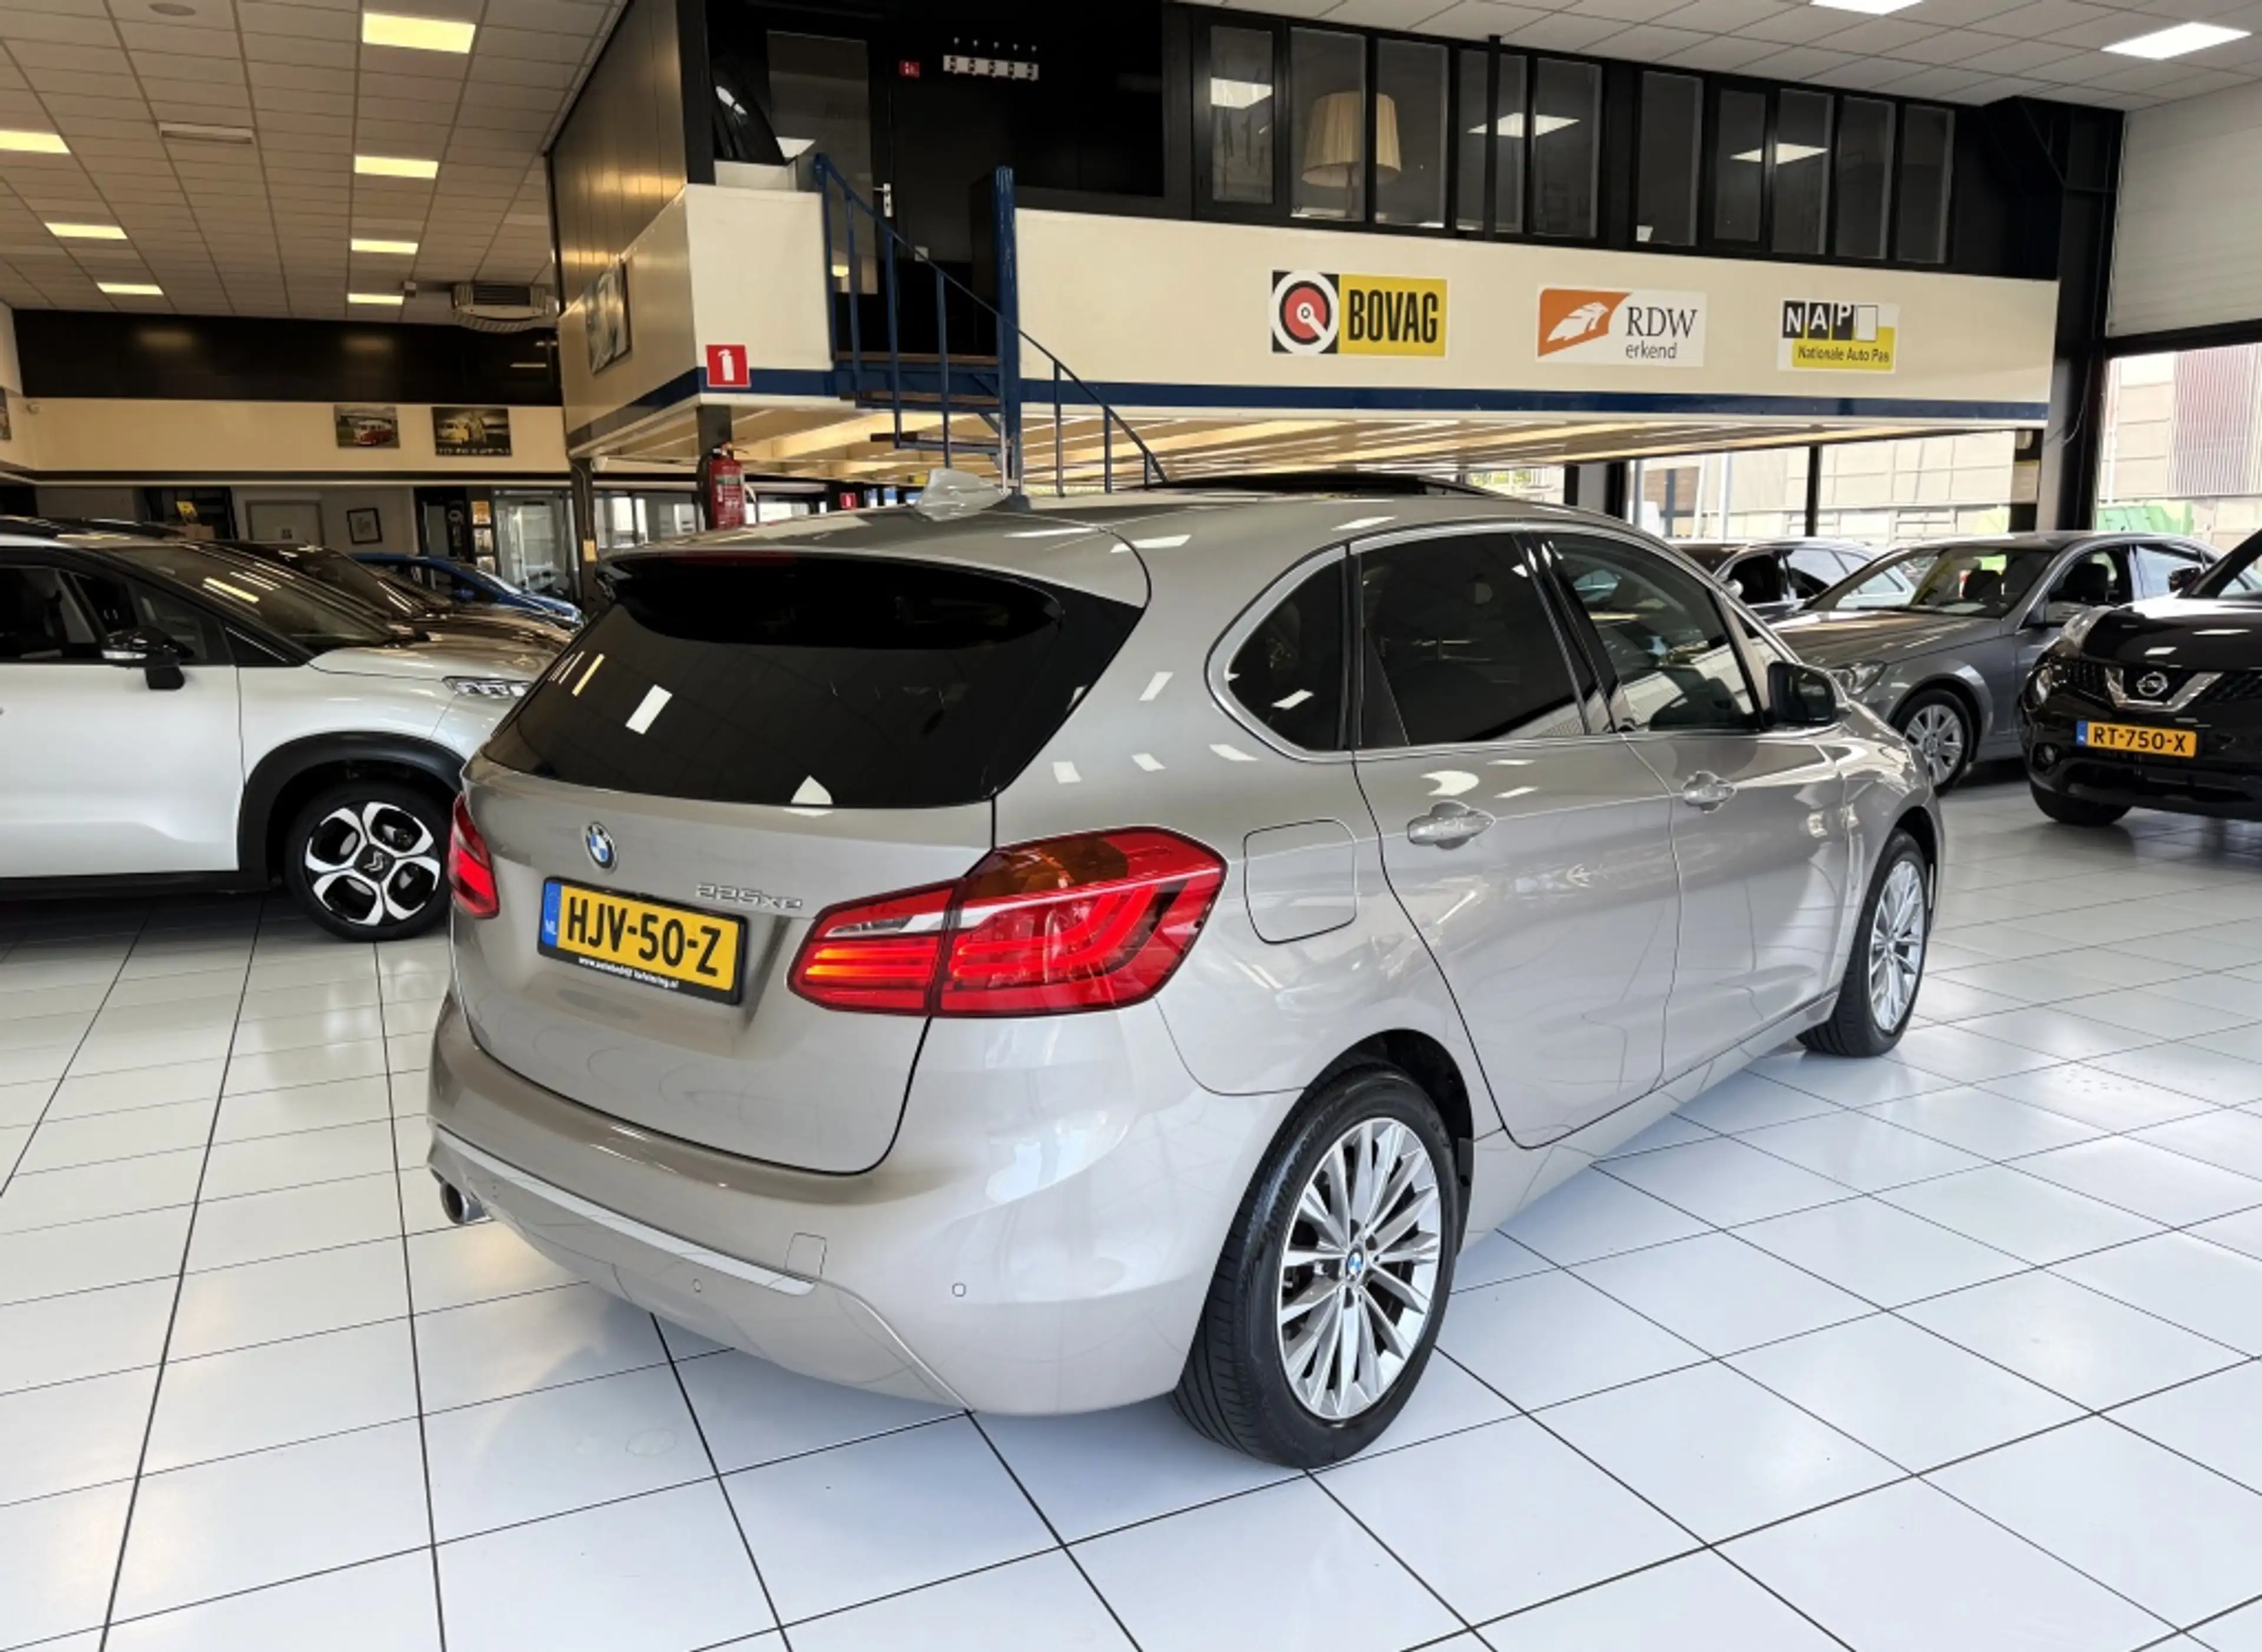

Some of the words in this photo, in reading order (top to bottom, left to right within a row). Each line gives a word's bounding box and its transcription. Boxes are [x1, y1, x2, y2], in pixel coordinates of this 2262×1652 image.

[1348, 289, 1438, 343] BOVAG
[1626, 306, 1698, 339] RDW
[1785, 304, 1853, 333] NAP
[1626, 340, 1677, 359] erkend
[1798, 346, 1844, 361] Nationale
[1846, 347, 1870, 362] Auto
[2093, 726, 2186, 753] RT-750-X
[567, 896, 722, 977] HJV-50-Z
